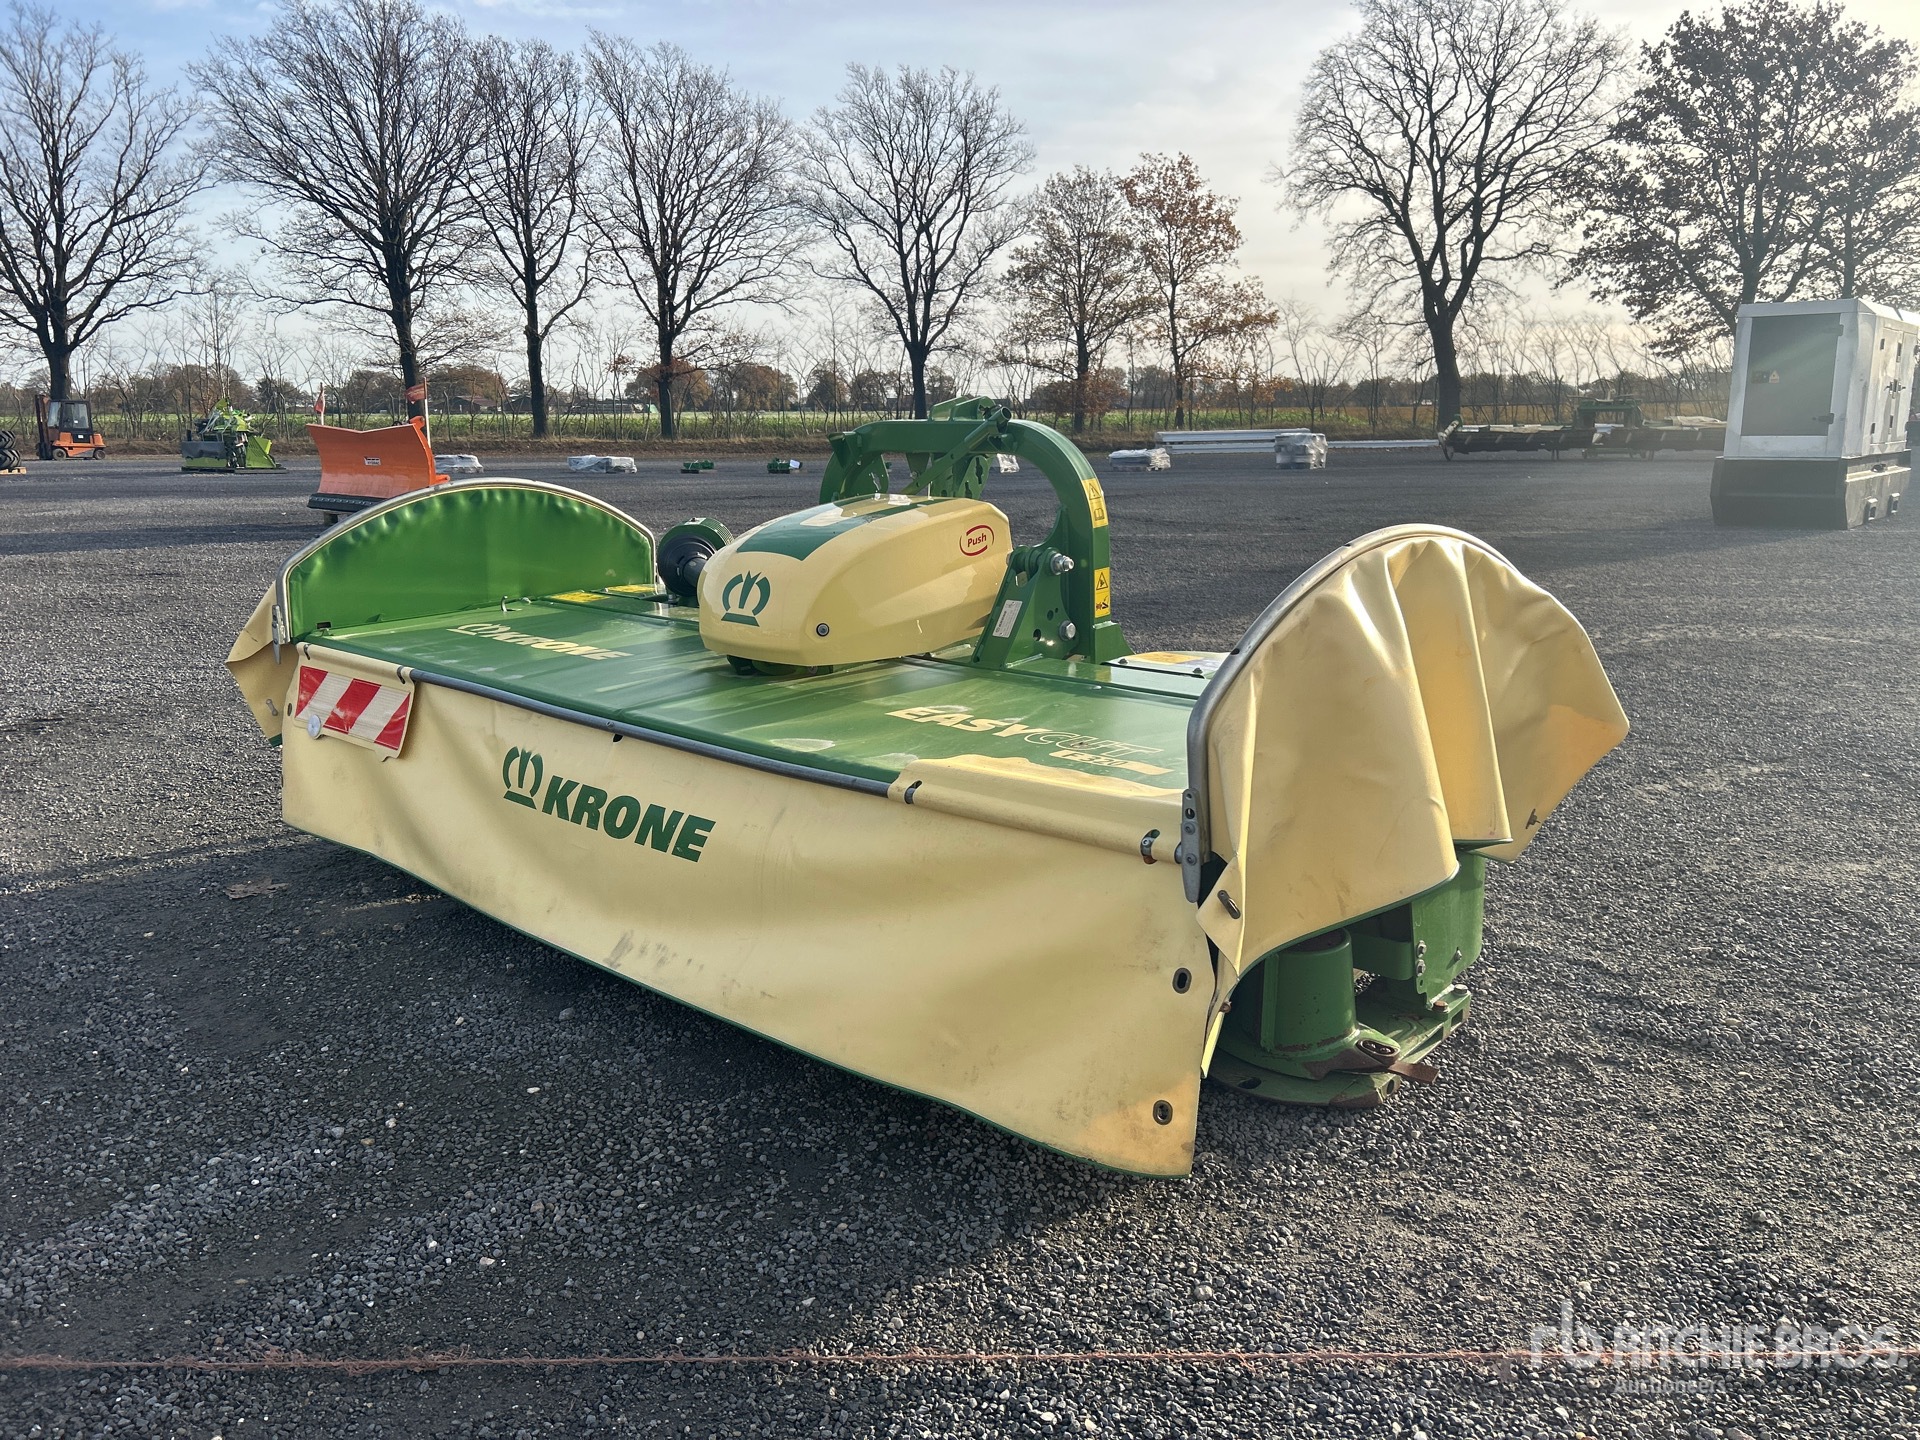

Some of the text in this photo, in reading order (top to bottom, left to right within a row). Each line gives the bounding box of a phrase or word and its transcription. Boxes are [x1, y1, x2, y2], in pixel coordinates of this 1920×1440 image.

[967, 532, 987, 548] Push
[479, 631, 635, 660] KRONE
[542, 775, 716, 862] KRONE
